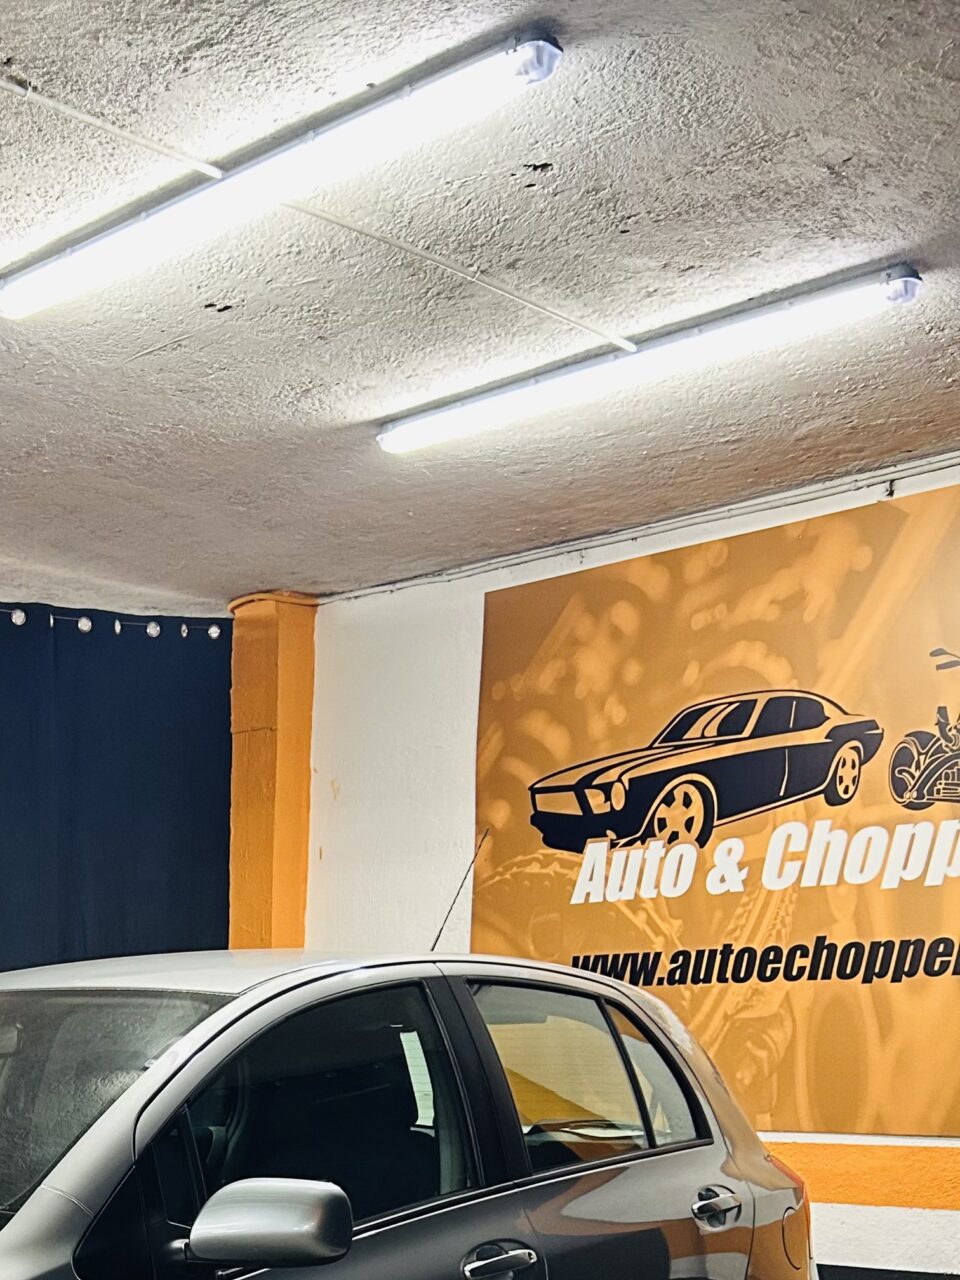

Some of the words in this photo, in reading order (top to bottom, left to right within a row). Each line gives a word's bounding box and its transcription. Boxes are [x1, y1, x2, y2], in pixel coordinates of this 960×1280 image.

[570, 841, 697, 904] Auto
[706, 838, 748, 893] &
[761, 819, 960, 890] Chopp
[571, 936, 960, 987] www.autoechoppe
